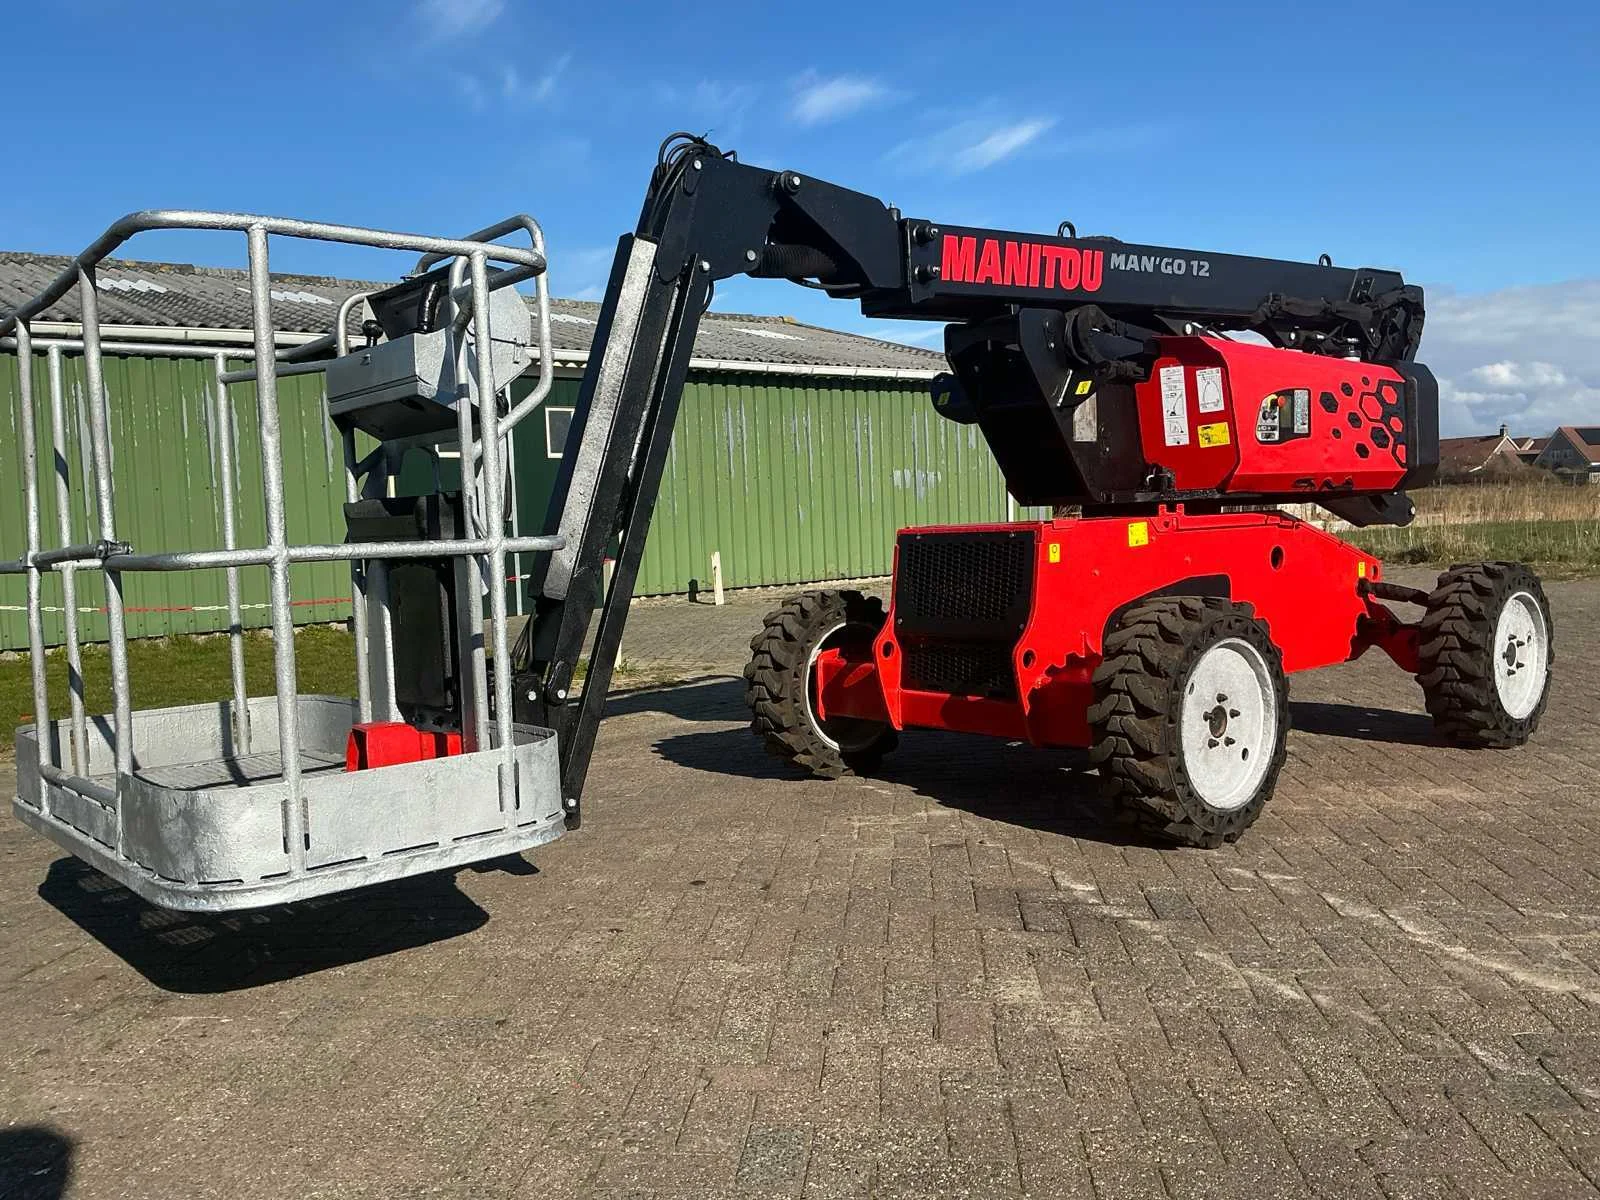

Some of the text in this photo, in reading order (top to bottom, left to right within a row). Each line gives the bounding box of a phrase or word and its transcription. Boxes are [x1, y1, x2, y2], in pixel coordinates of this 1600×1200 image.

[941, 234, 1104, 292] MANITOU
[1110, 253, 1210, 277] MAN'GO 12
